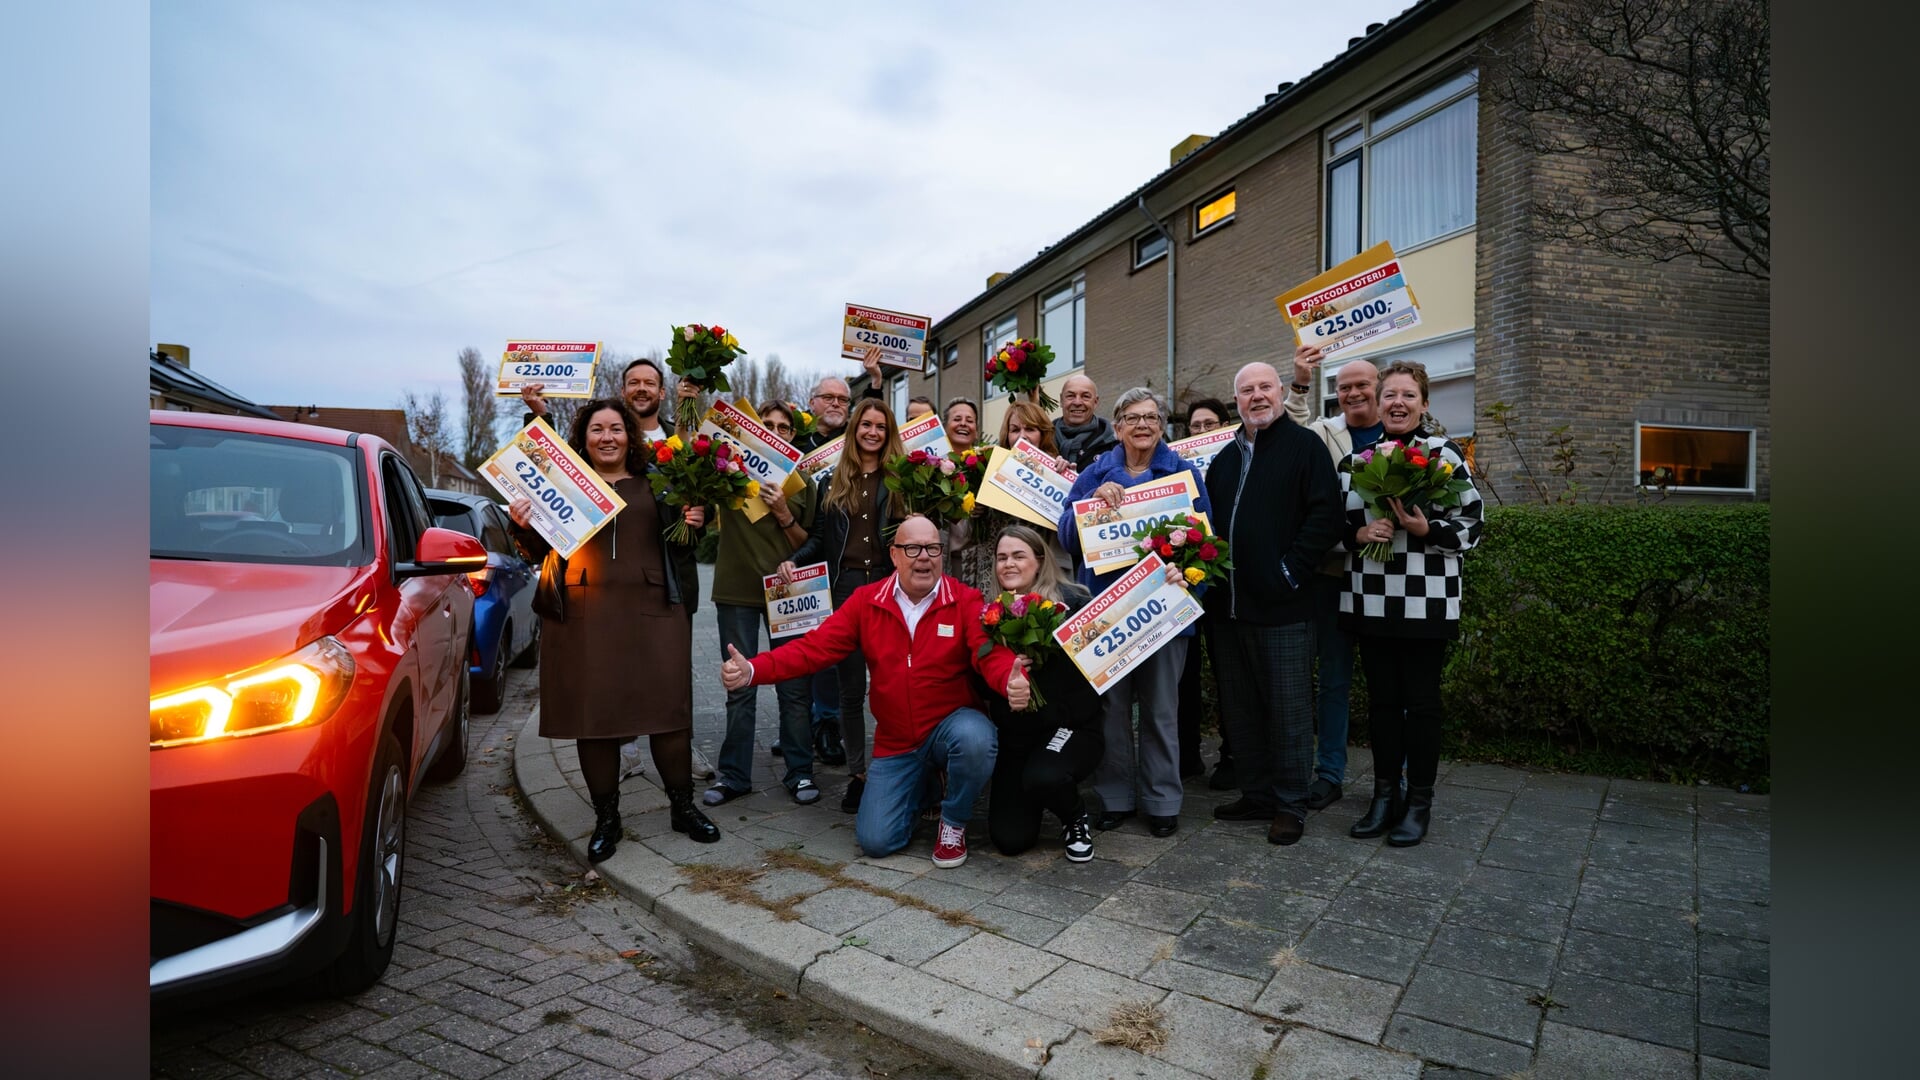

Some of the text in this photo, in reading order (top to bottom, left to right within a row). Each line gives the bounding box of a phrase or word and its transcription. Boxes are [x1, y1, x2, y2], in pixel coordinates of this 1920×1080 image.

[1300, 269, 1386, 310] POSTCODE LOTERIJ
[855, 309, 917, 327] POSTCODE LOTERIJ
[723, 407, 791, 455] POSTCODE LOTERIJ
[904, 422, 931, 439] LOTERIJ
[801, 446, 836, 467] POSTCODE
[1026, 447, 1058, 471] POSTCO
[537, 436, 577, 477] POSTCODE
[573, 473, 605, 504] LOTERIJ
[1139, 486, 1174, 500] LOTERIJ
[798, 568, 820, 579] LOTERIJ
[1068, 566, 1148, 633] POSTCODE LOTERIJ
